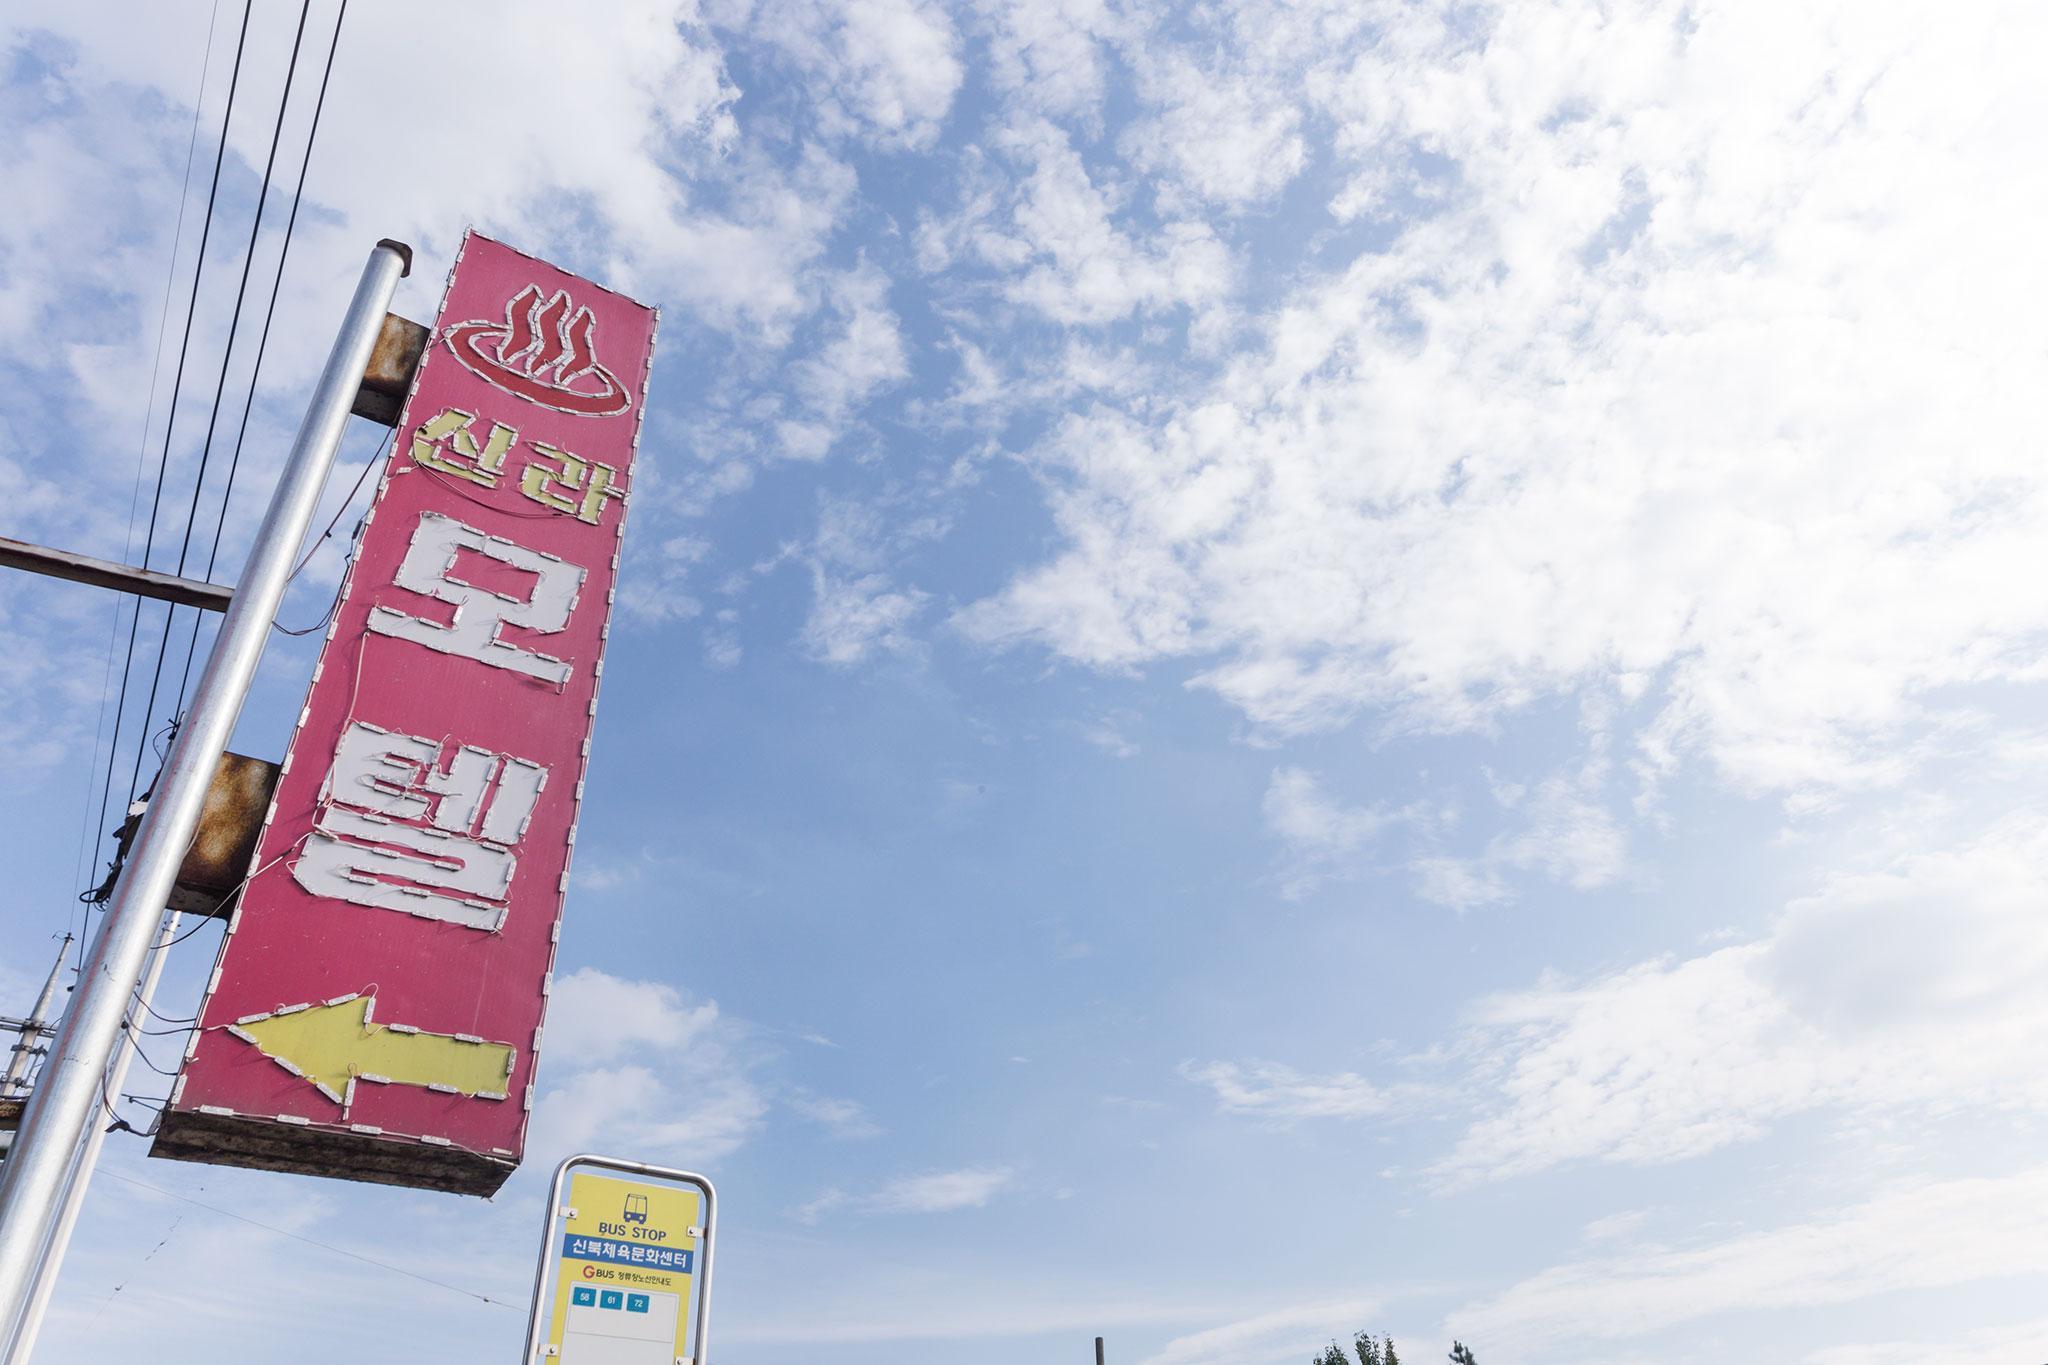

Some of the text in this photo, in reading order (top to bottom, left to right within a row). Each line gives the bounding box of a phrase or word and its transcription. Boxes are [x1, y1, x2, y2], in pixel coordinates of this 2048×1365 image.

[411, 407, 625, 526] 신라
[294, 509, 588, 933] 모텔
[599, 1222, 667, 1242] BUS STOP
[573, 1239, 687, 1268] 신북체육문화센터
[607, 1296, 616, 1305] 61
[634, 1299, 644, 1308] 72
